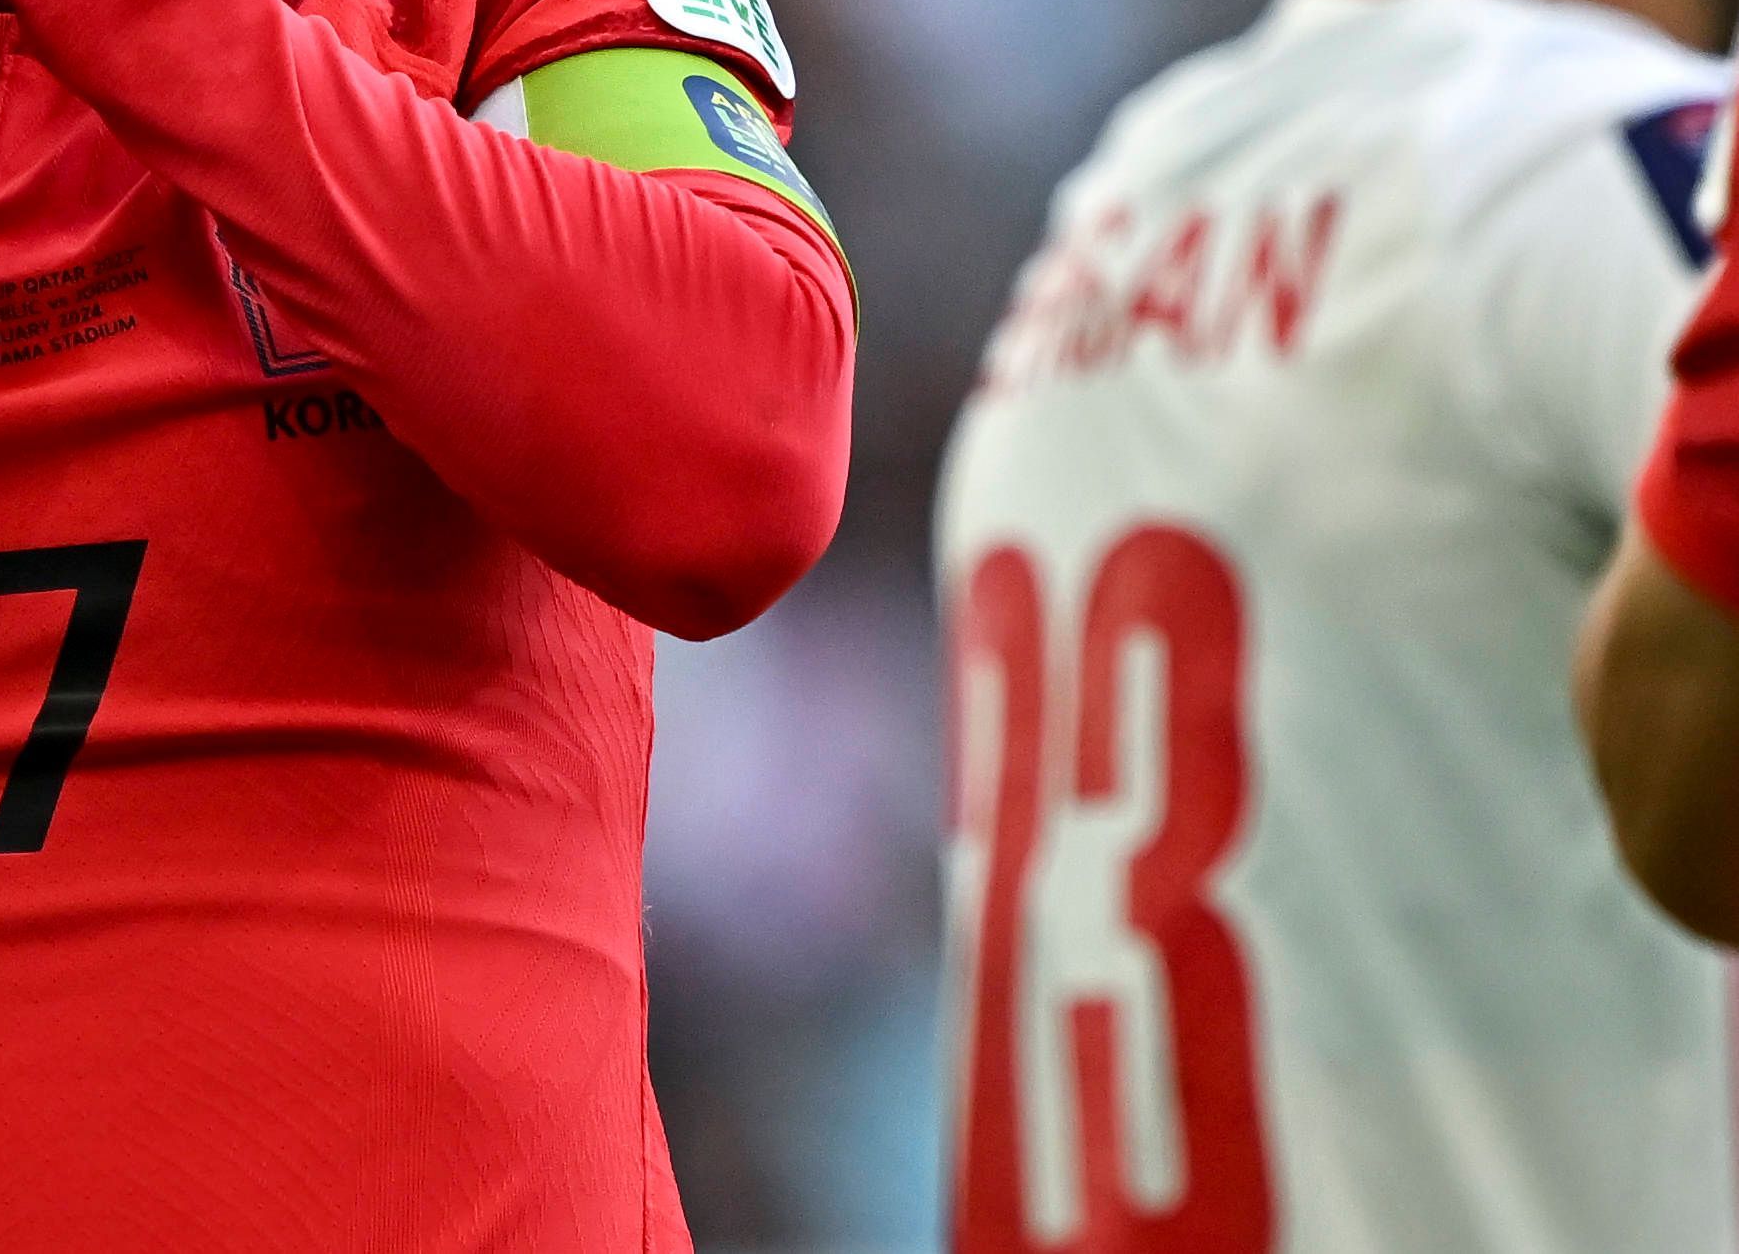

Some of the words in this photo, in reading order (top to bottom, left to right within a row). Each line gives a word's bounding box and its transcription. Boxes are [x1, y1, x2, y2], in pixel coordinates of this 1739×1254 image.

[23, 265, 85, 294] QATAR
[75, 266, 149, 303] JORDAN
[59, 302, 103, 328] 2024
[49, 315, 137, 354] STADIUM
